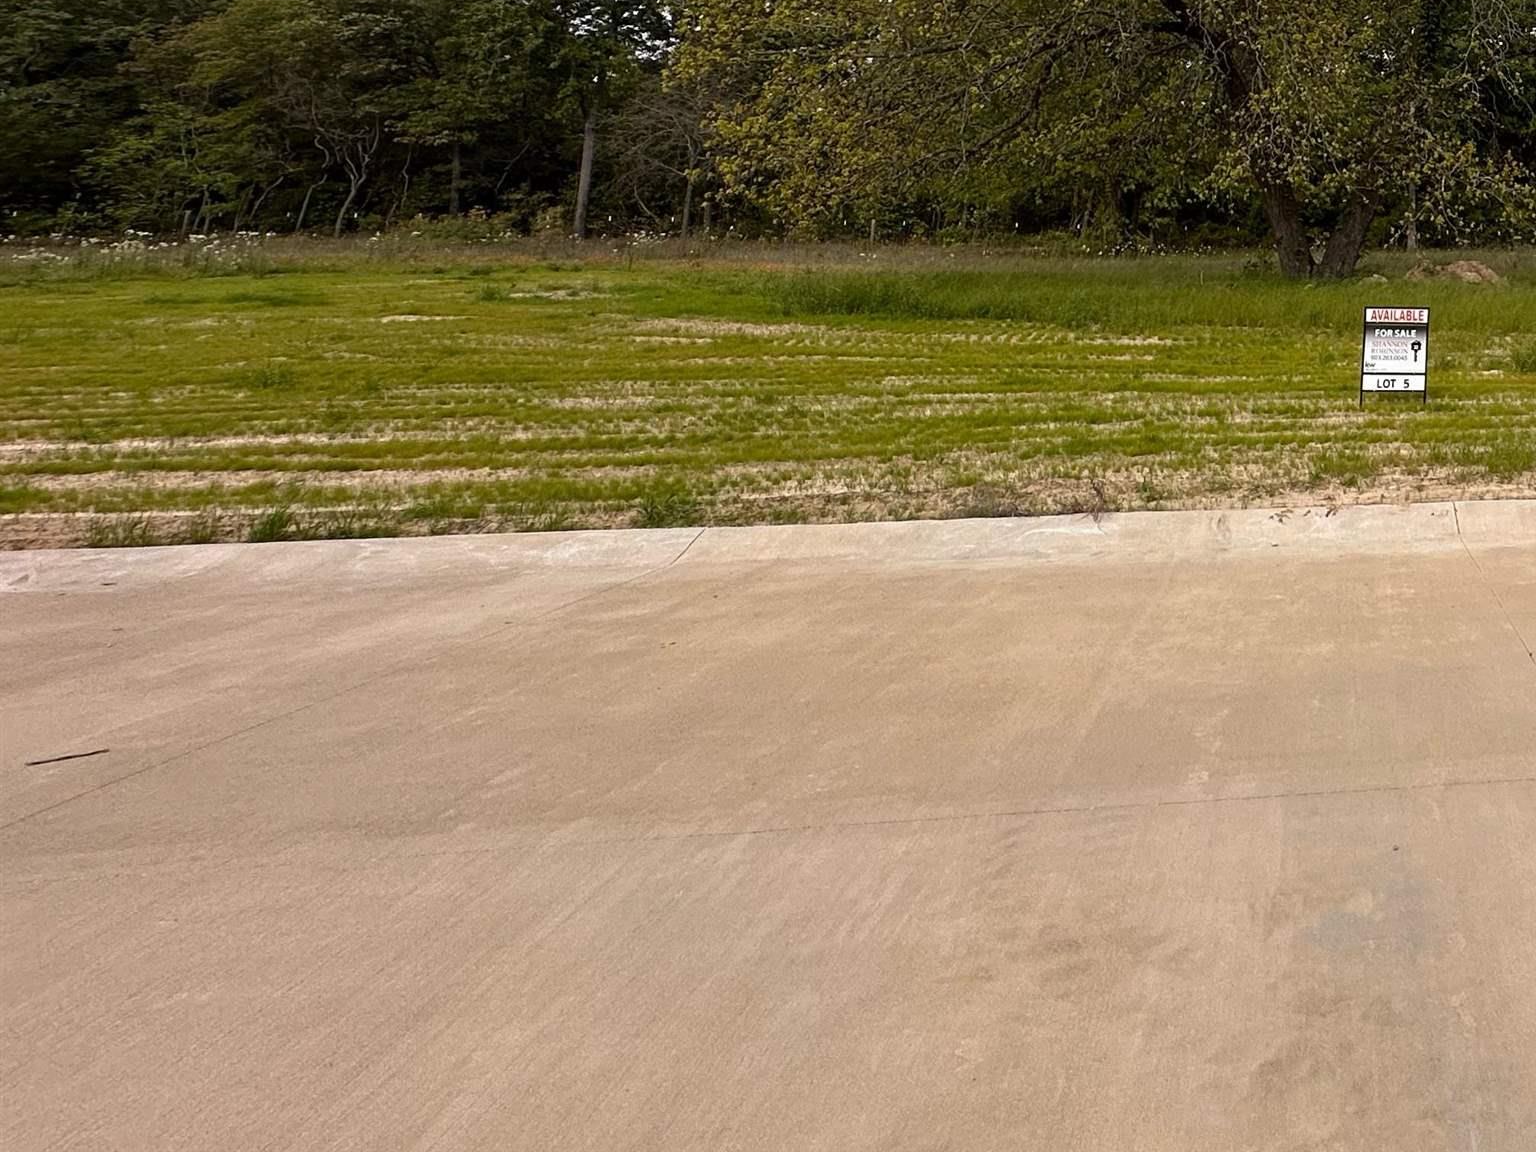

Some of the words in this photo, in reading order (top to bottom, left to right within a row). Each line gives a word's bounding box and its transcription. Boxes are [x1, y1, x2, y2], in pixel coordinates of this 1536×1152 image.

[1370, 310, 1424, 321] AVAILABLE
[1374, 329, 1393, 337] FOR
[1394, 329, 1417, 338] SALE
[1376, 379, 1396, 388] LOT
[1403, 379, 1410, 388] 5
